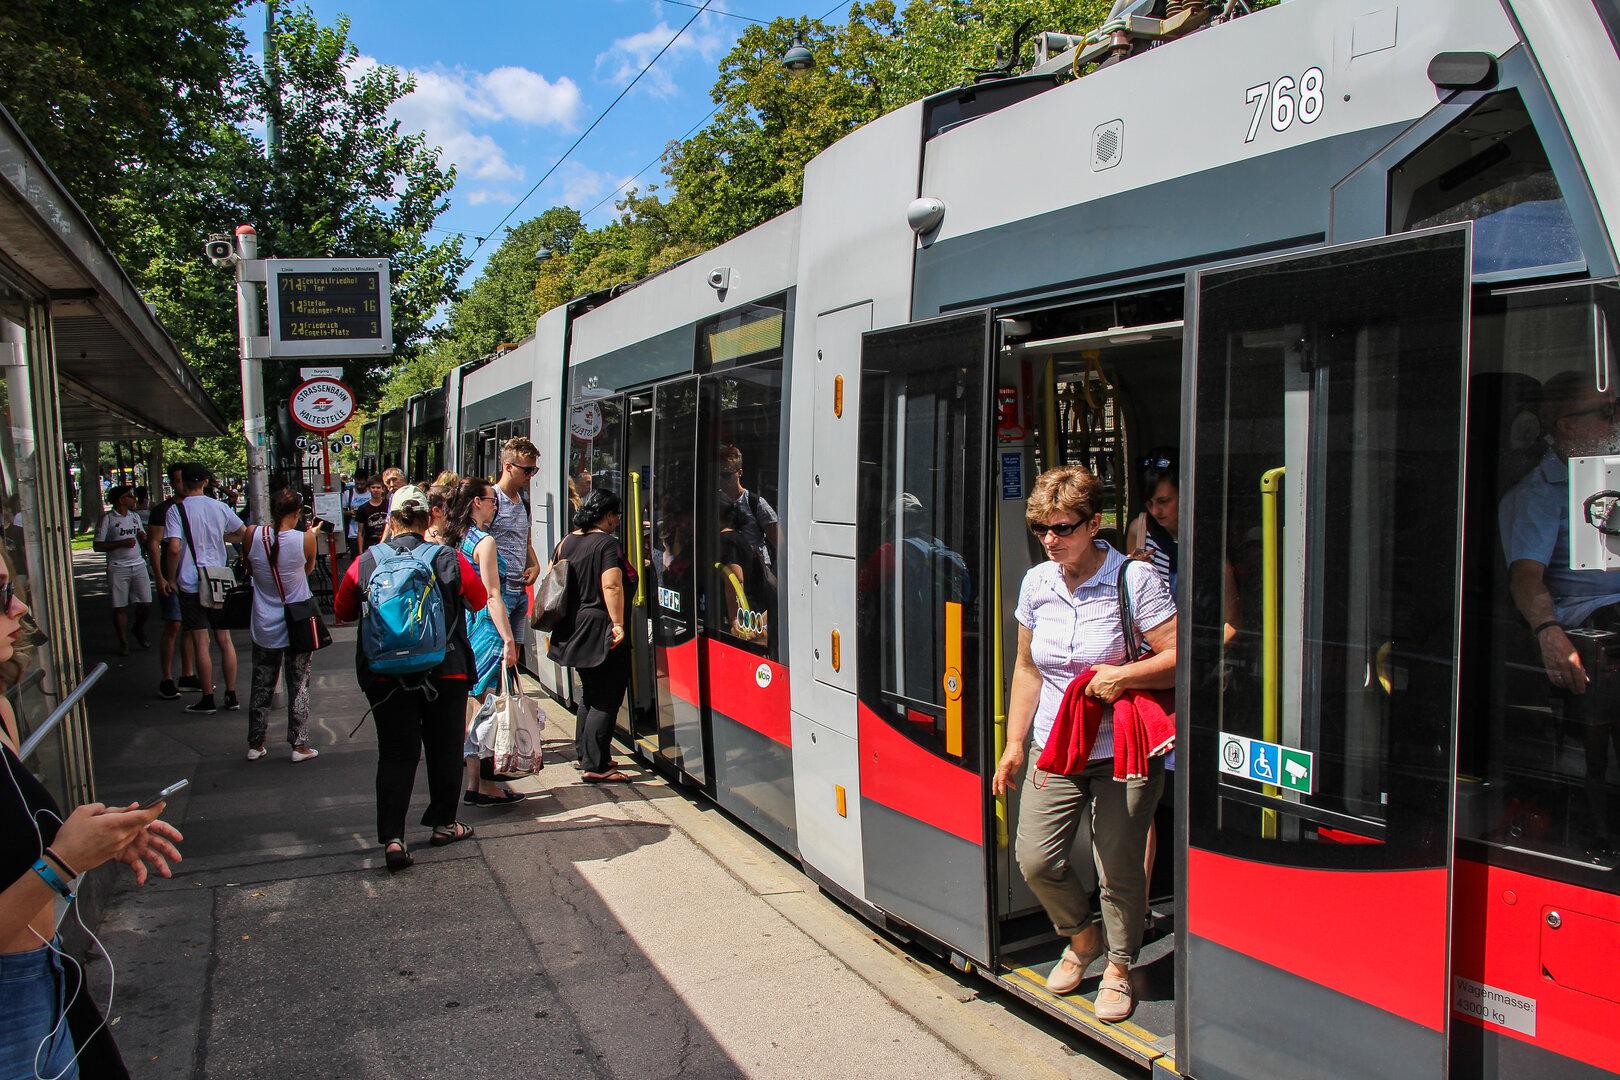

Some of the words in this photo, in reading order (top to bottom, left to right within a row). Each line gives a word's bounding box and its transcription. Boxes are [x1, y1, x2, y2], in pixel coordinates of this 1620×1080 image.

[1244, 66, 1324, 144] 768
[282, 279, 295, 291] 71
[302, 277, 358, 285] Zentralfriedhof
[368, 278, 375, 290] 3
[290, 300, 295, 313] 1
[363, 300, 376, 312] 16
[291, 323, 298, 336] 2
[370, 322, 377, 334] 3
[297, 384, 349, 402] STRASSENBAHN
[300, 409, 346, 424] HALTESTELLE
[298, 438, 307, 446] 71
[344, 436, 352, 444] D
[310, 445, 318, 453] 2
[1457, 980, 1534, 1012] Wagenmasse:
[1456, 998, 1489, 1016] 43000
[1492, 1009, 1505, 1024] kg
